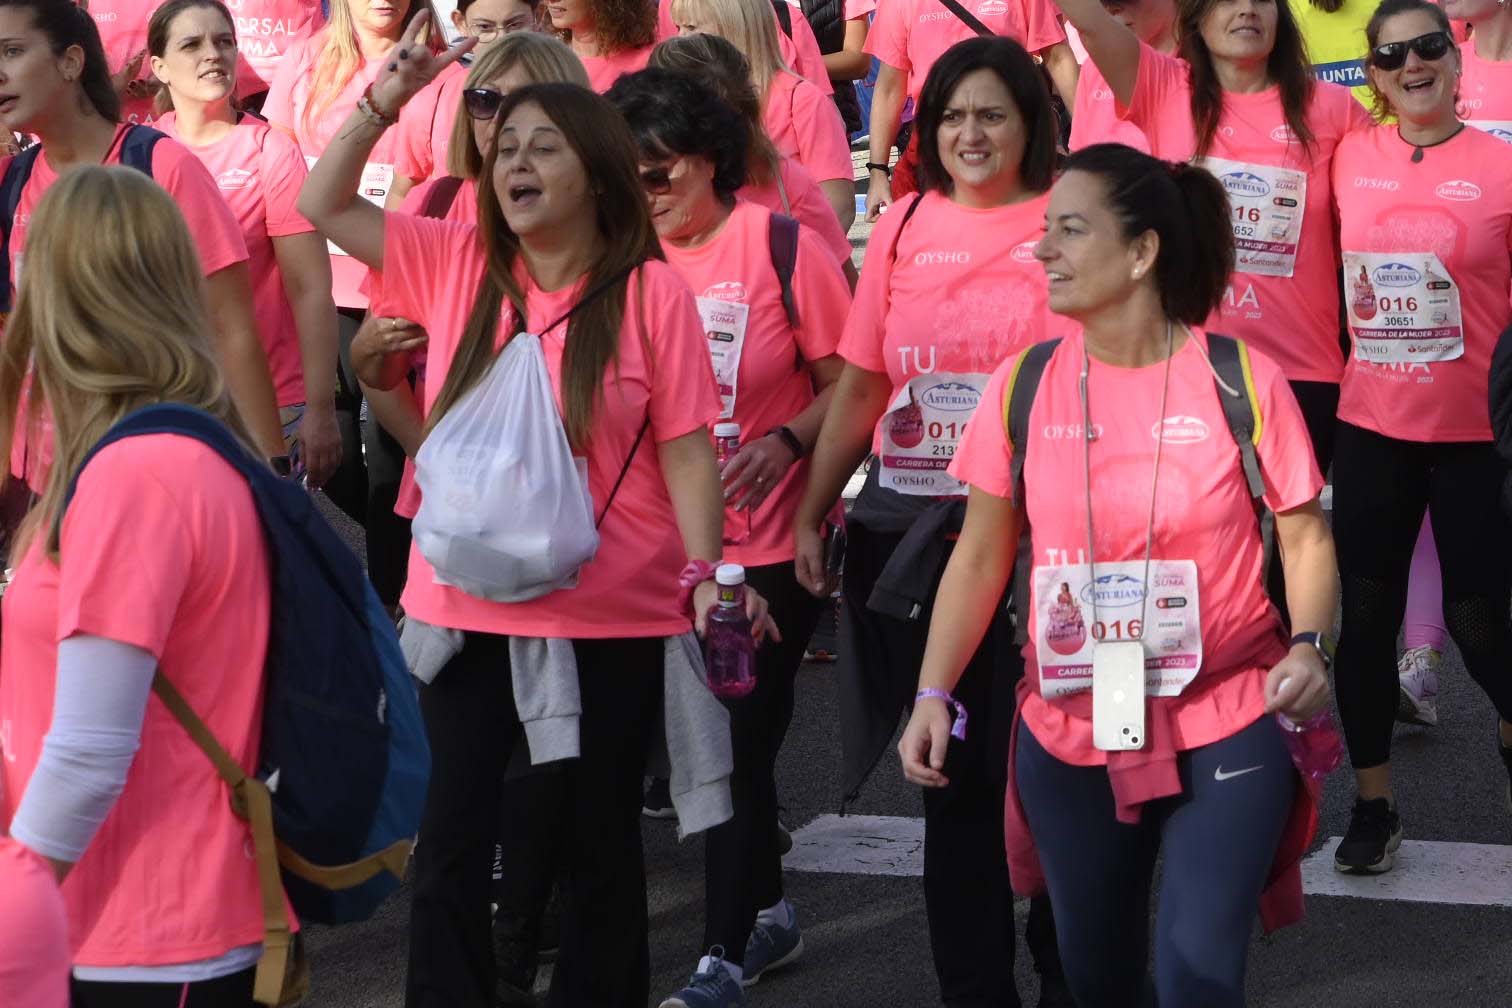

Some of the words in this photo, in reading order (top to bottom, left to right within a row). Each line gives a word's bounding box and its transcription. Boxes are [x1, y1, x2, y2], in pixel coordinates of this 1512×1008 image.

[919, 10, 952, 24] OYSHO
[1274, 182, 1299, 192] SUMA
[914, 250, 971, 266] OYSHO
[1379, 296, 1419, 312] 016
[710, 314, 736, 325] SUMA
[1384, 316, 1415, 327] 30651
[1358, 329, 1388, 338] CARRERA
[1408, 330, 1433, 338] MUJER
[897, 345, 936, 376] TU
[896, 459, 934, 469] CARRERA
[892, 475, 936, 487] OYSHO
[1153, 576, 1186, 588] SUMA
[1091, 619, 1144, 641] 016
